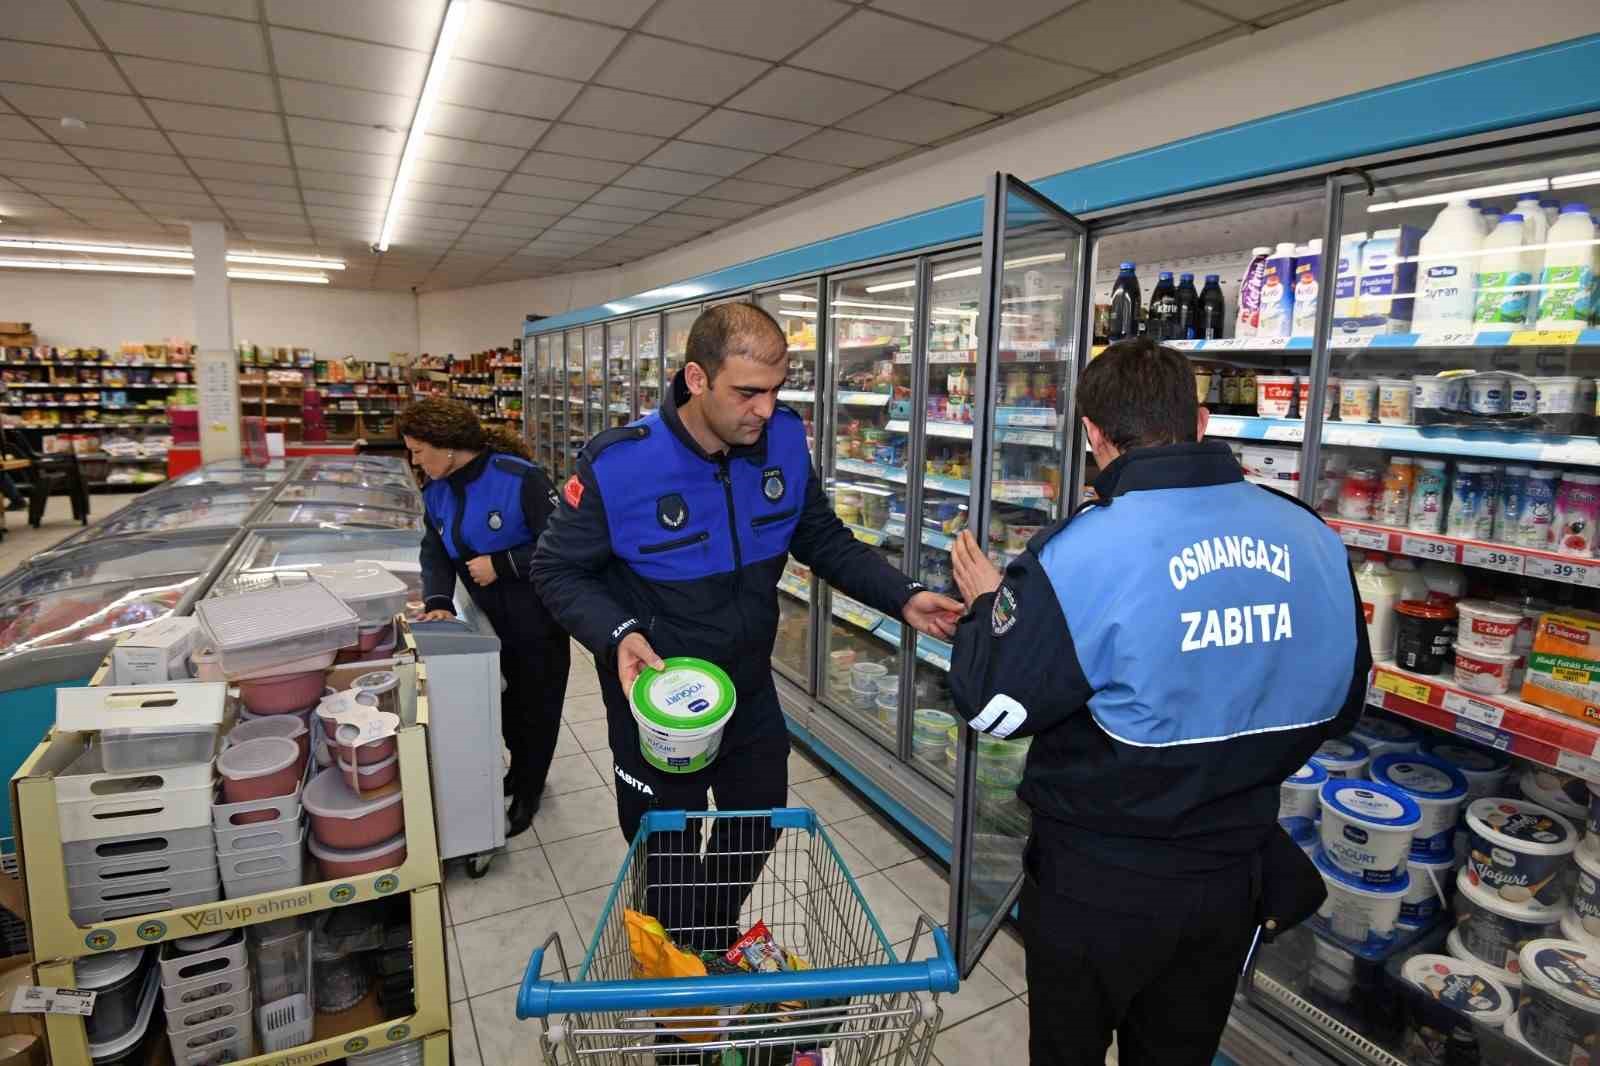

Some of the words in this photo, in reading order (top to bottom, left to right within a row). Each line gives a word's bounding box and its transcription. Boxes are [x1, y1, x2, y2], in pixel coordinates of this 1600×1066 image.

[1427, 543, 1445, 555] 39
[1487, 552, 1507, 565] 39
[1552, 563, 1573, 577] 39
[1180, 602, 1293, 652] ZABITA
[615, 763, 654, 796] ZABITA
[224, 906, 253, 922] vip
[256, 891, 313, 915] ahmet
